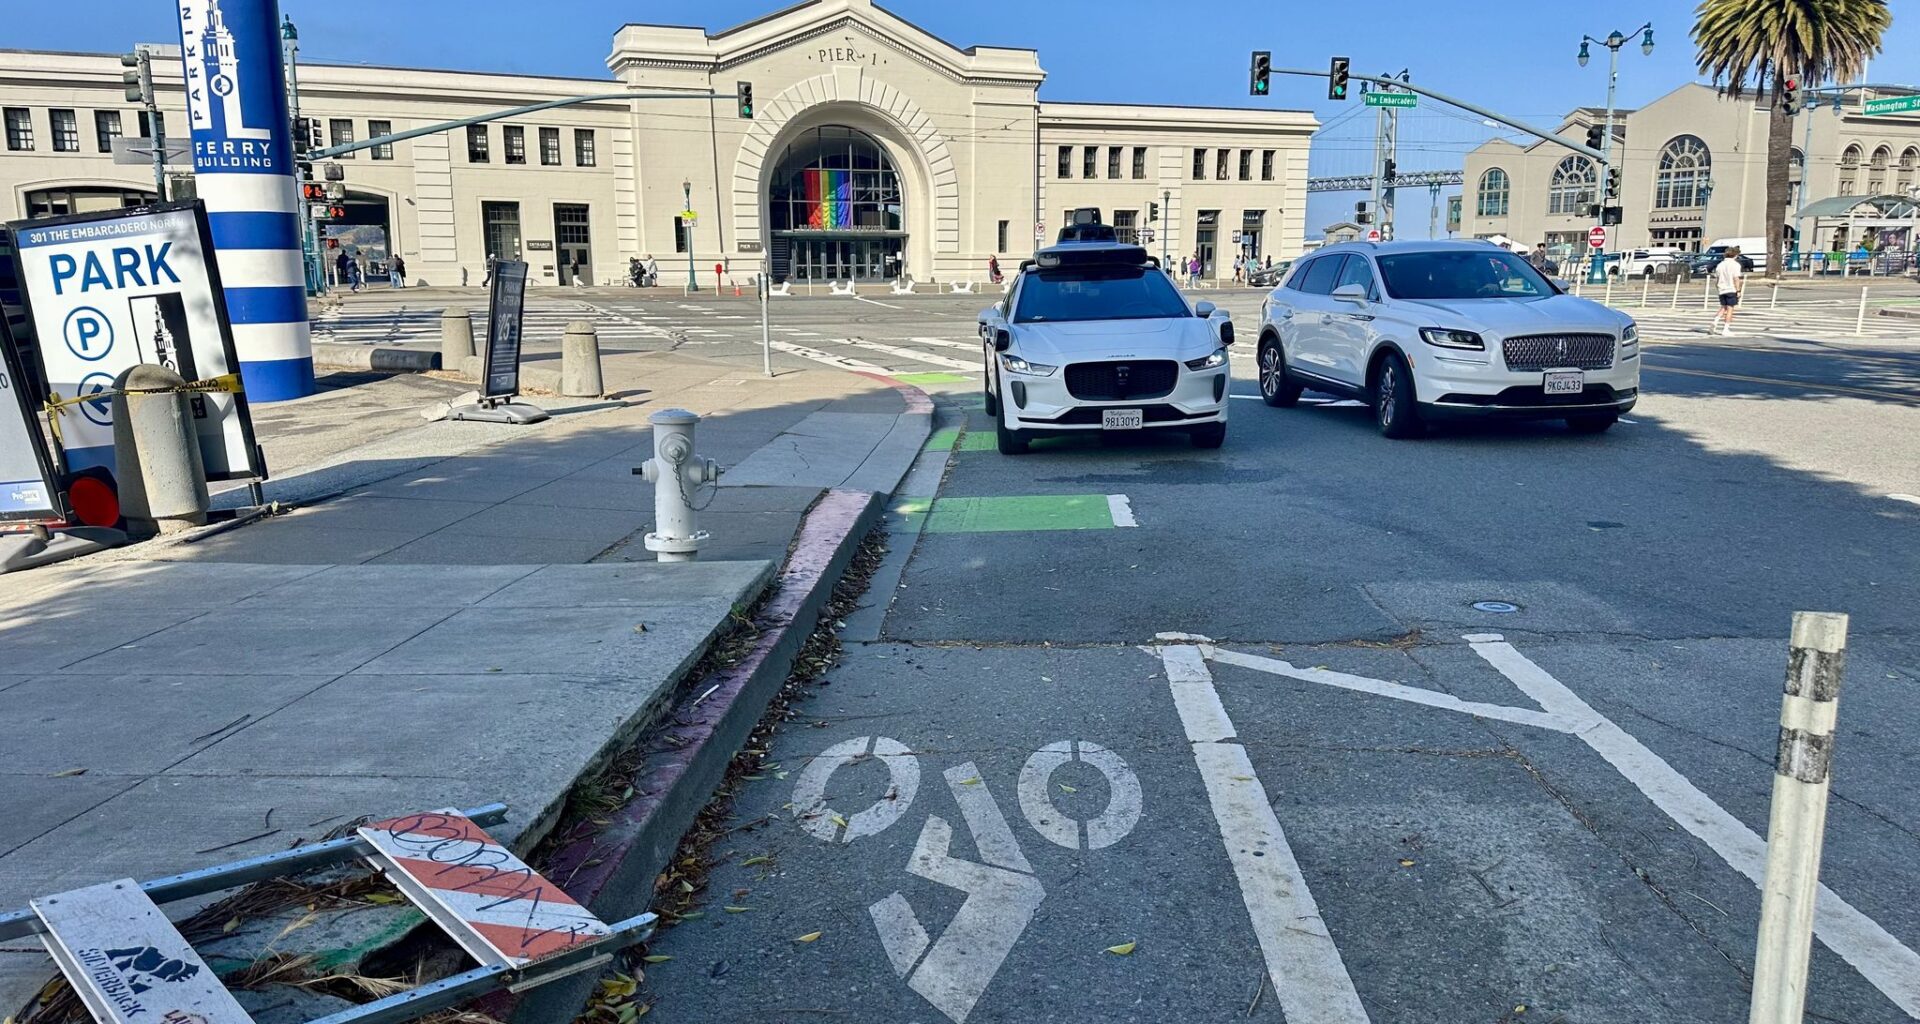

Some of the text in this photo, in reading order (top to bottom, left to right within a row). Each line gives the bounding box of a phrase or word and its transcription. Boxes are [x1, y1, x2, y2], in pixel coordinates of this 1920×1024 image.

[182, 7, 203, 121] PARKIN
[818, 48, 877, 65] PIER 1
[1367, 95, 1417, 105] The Embarcadero
[1866, 99, 1920, 112] Washington St
[196, 142, 270, 155] FERRY
[198, 157, 272, 167] BUILDING
[30, 218, 185, 243] 301 THE EMBARCADERO NORTH
[49, 242, 181, 295] PARK
[77, 317, 100, 351] P
[1547, 381, 1581, 391] 9KGJ433
[1105, 417, 1140, 427] 98130Y3
[79, 948, 147, 1018] SILVERBACK
